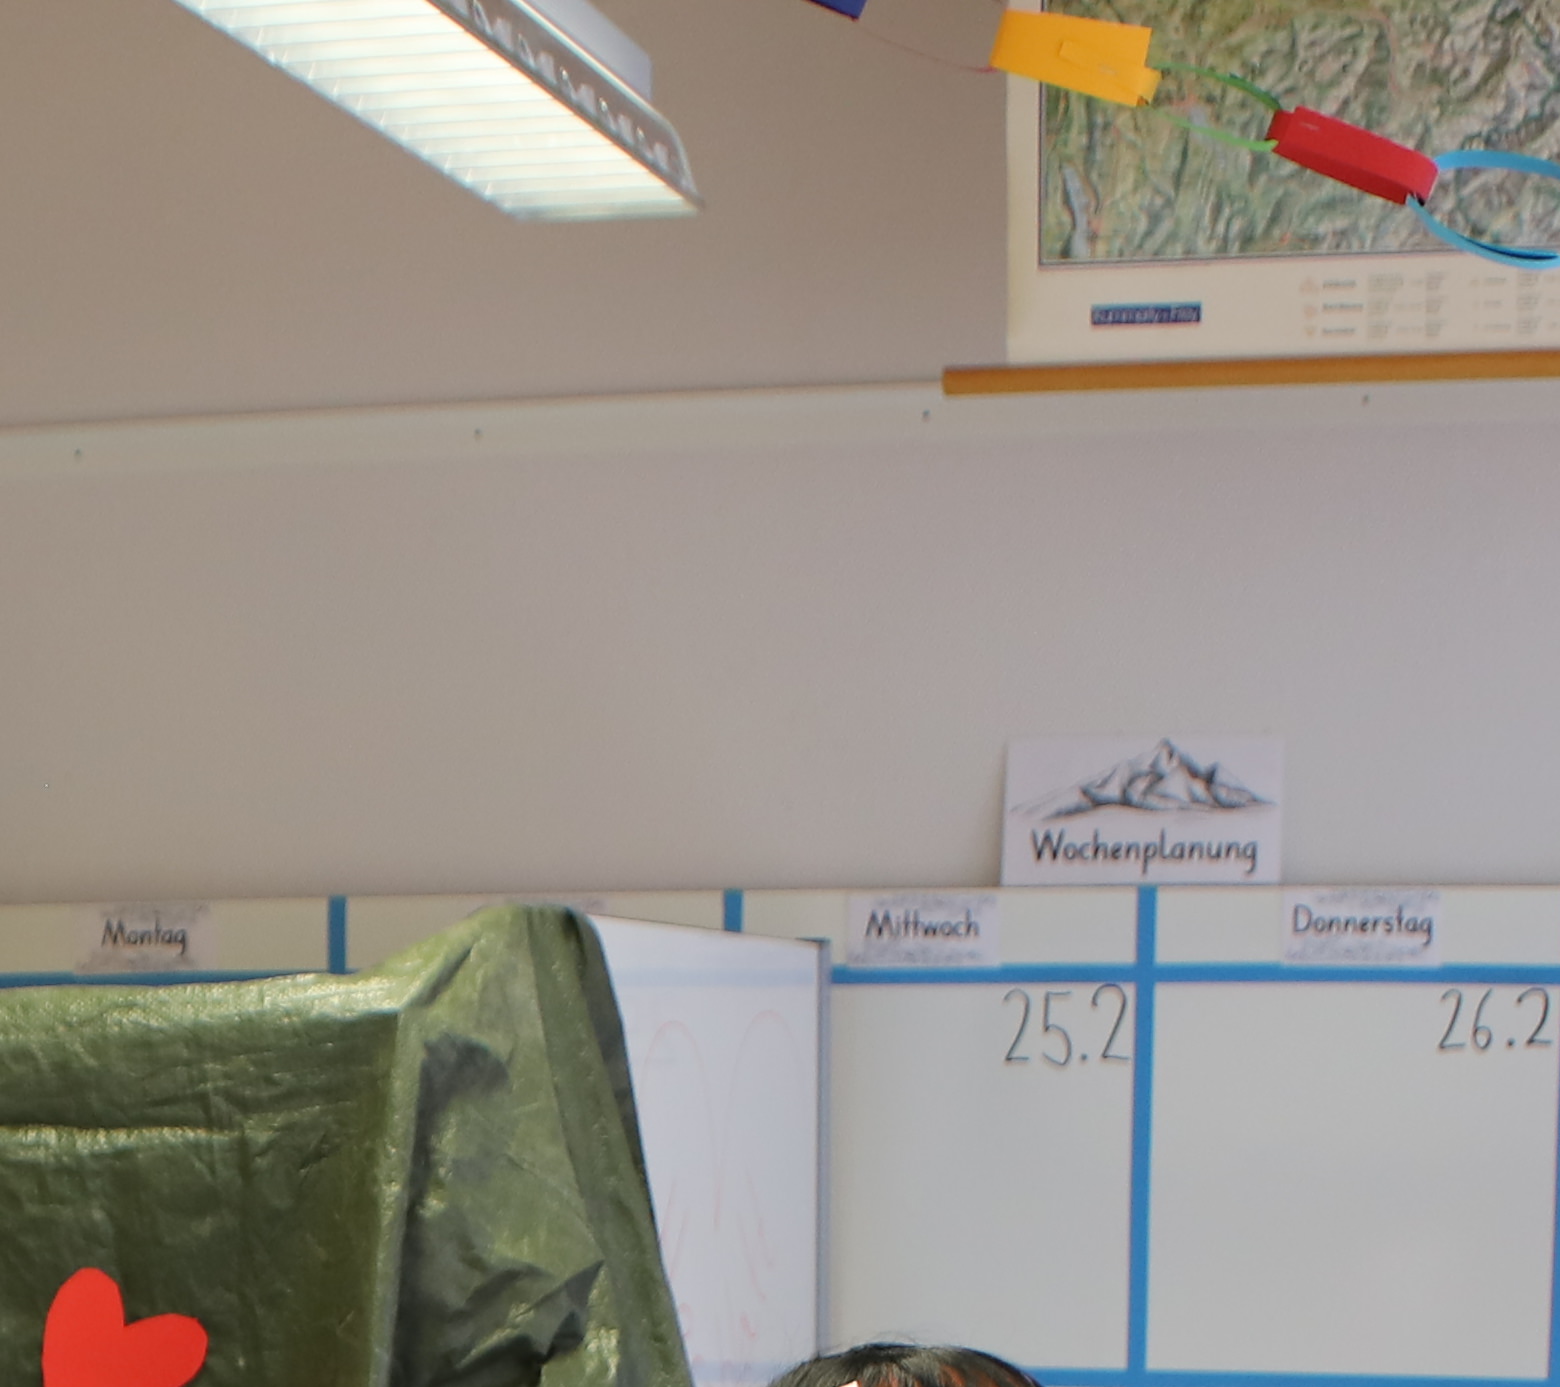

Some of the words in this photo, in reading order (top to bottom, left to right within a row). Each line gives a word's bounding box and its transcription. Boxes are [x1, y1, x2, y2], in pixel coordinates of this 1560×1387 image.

[1029, 829, 1258, 874] Wochenplanung
[102, 918, 189, 956] Montag
[865, 909, 979, 940] Mittwoch
[1291, 905, 1434, 946] Donnerstag
[1003, 983, 1131, 1066] 25.2
[1437, 987, 1553, 1052] 26.2
